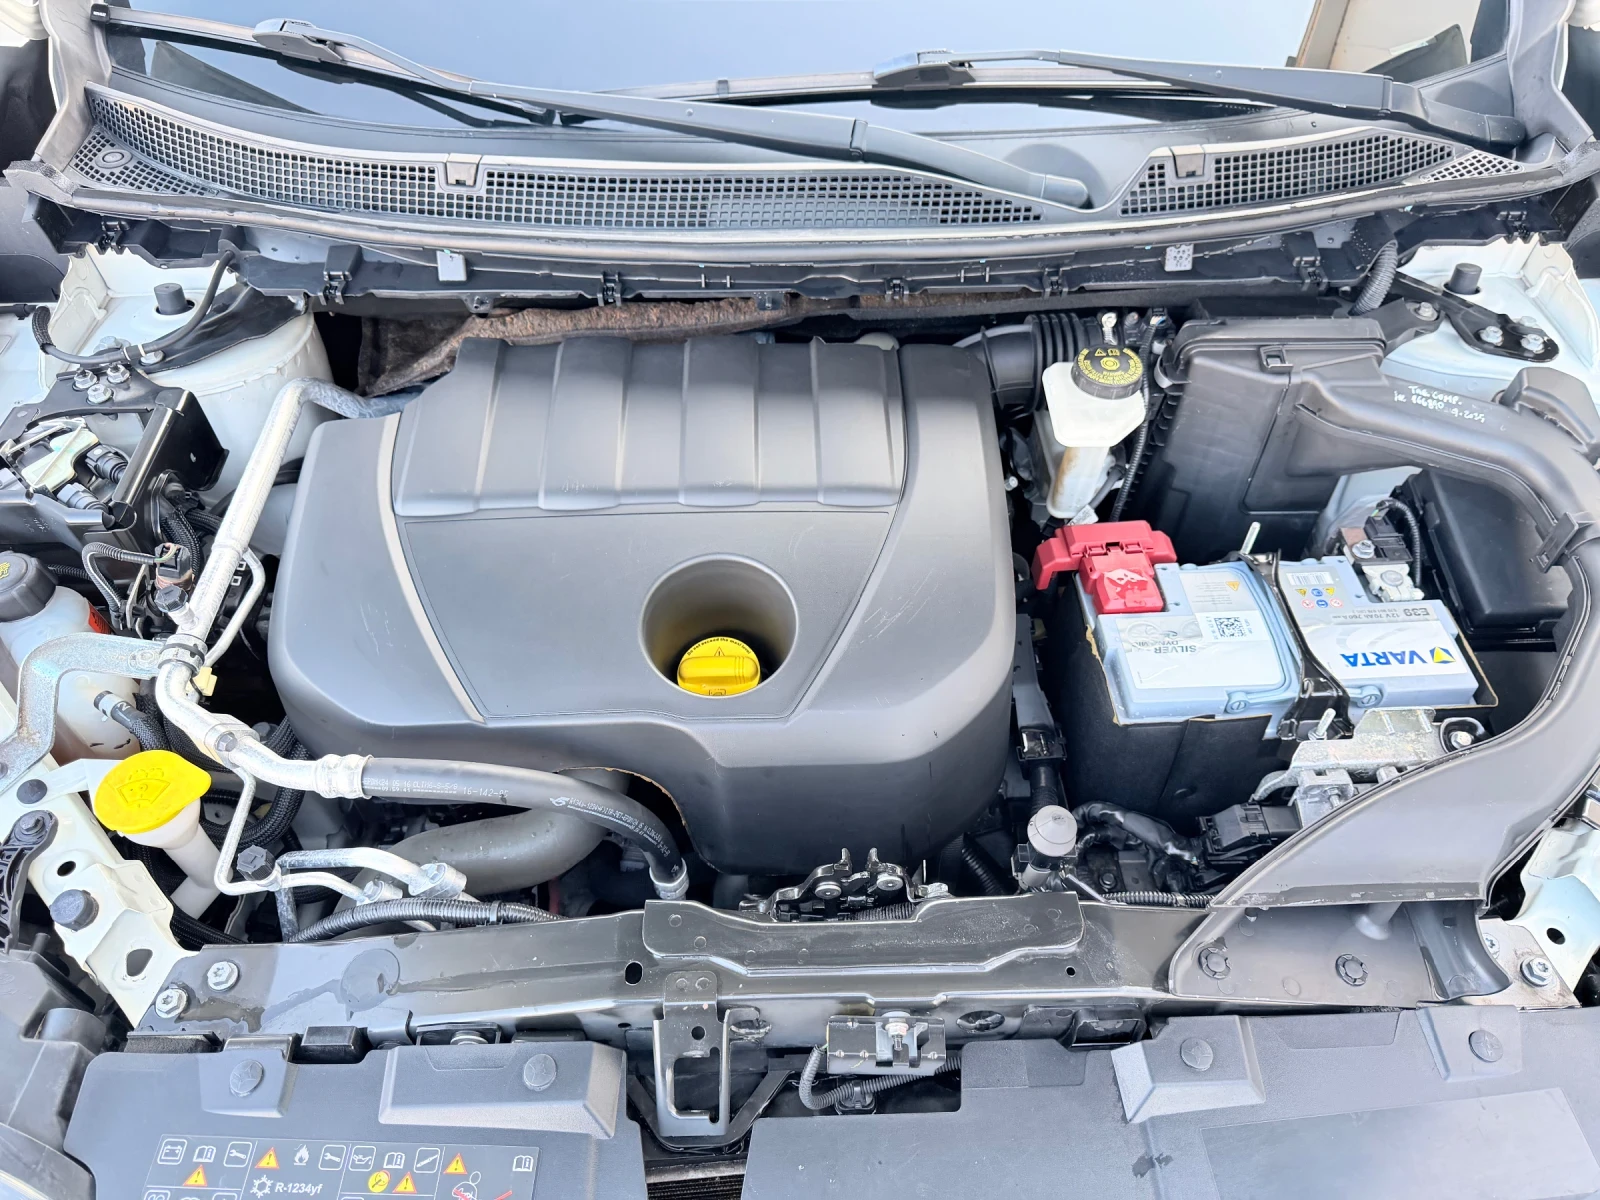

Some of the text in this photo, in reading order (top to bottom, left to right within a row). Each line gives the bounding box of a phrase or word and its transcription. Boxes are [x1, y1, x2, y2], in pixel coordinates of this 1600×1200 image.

[1403, 607, 1431, 617] E39
[701, 638, 720, 646] exceed
[1154, 645, 1197, 654] SILVER
[1340, 650, 1428, 667] VARTA
[274, 1182, 324, 1196] R-1234yf
